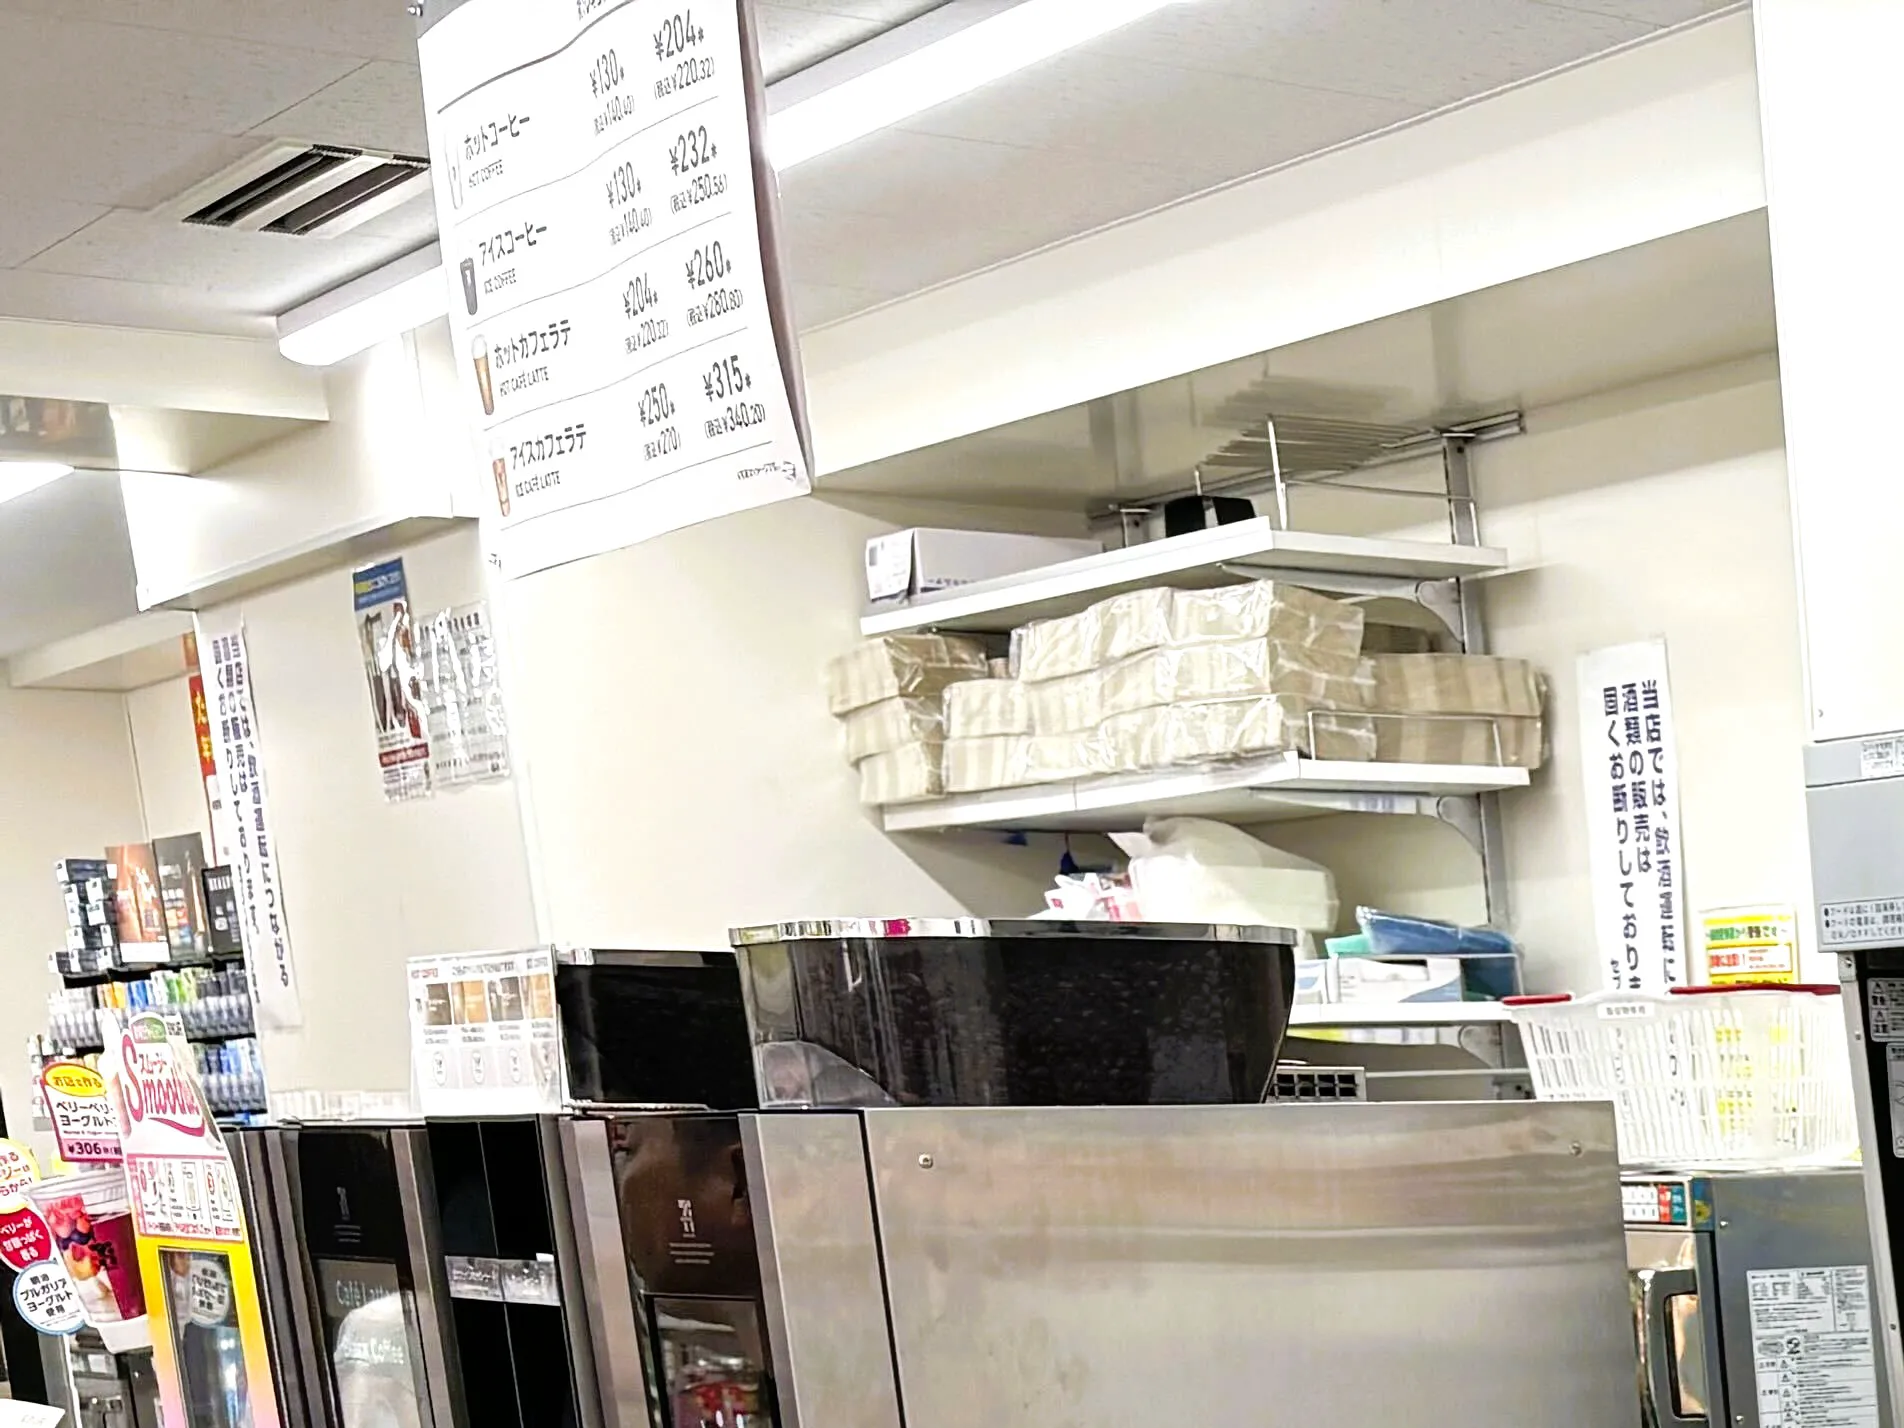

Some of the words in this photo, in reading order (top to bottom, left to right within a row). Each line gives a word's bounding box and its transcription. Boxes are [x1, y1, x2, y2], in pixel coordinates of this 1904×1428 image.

[478, 222, 548, 267] アイスコーヒー
[509, 423, 587, 472] アイスカフェラテ
